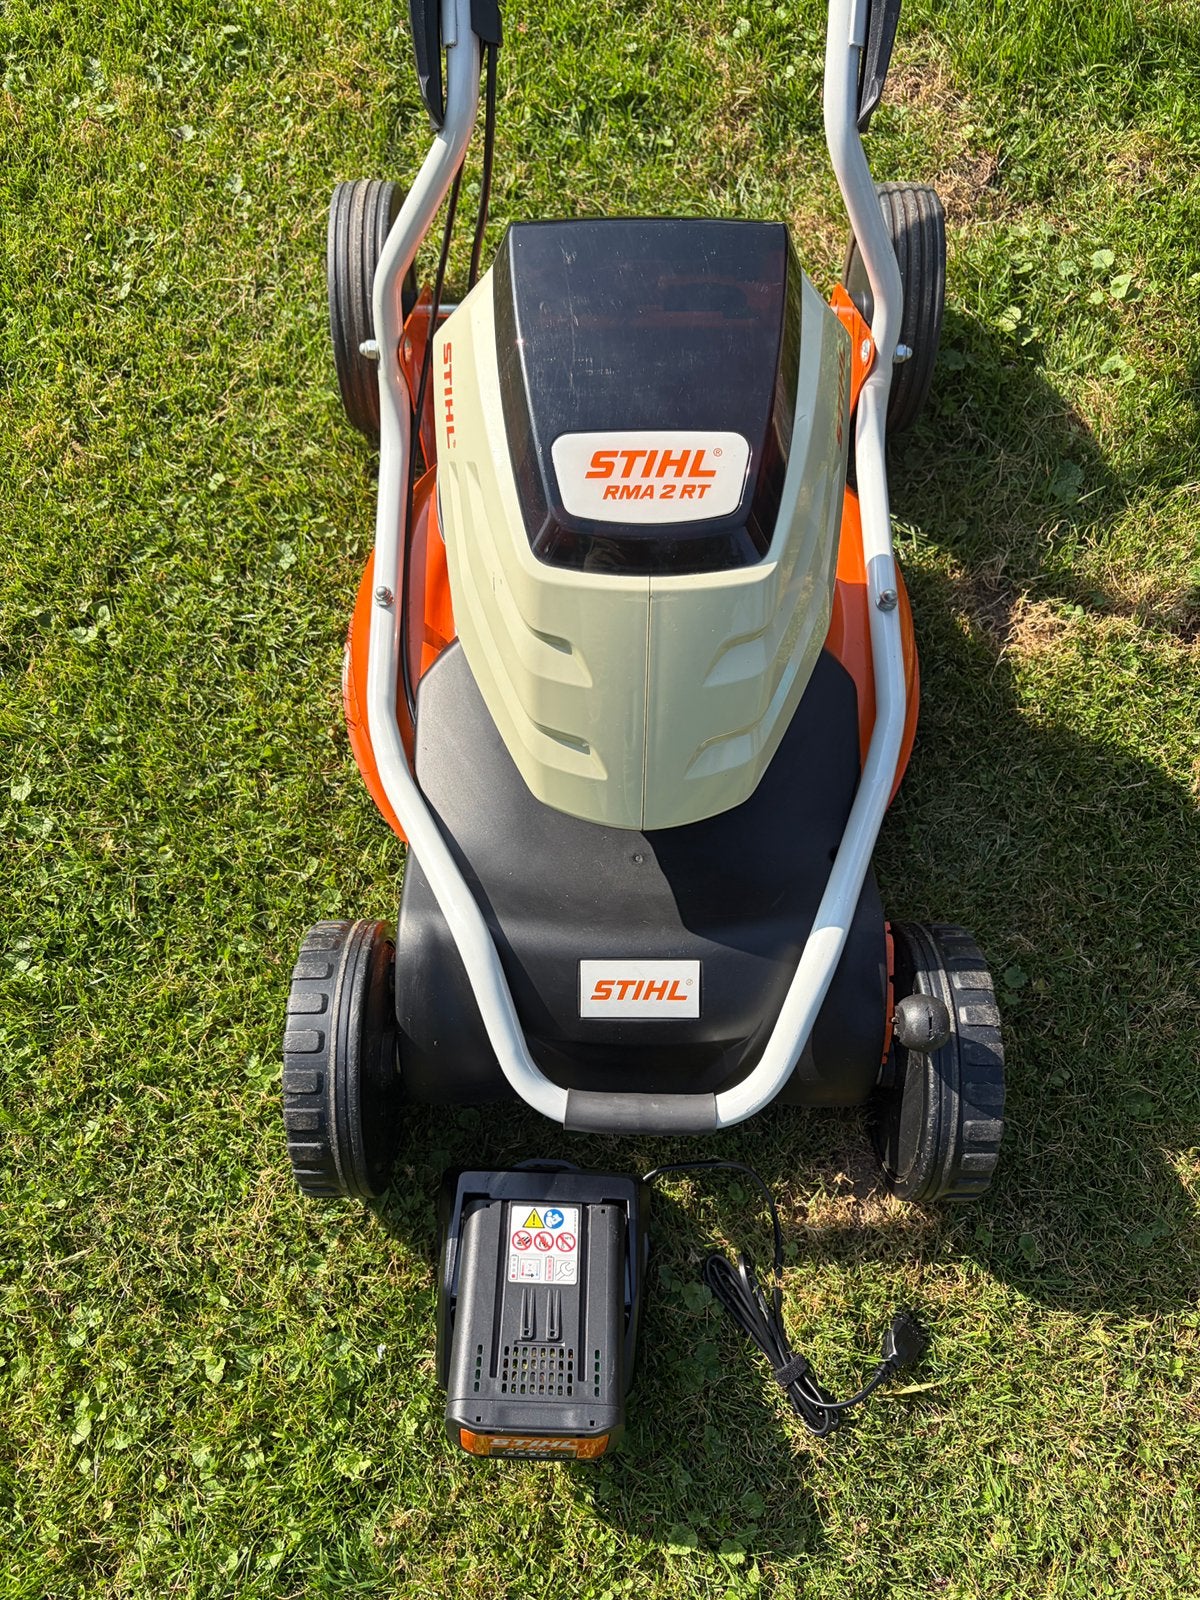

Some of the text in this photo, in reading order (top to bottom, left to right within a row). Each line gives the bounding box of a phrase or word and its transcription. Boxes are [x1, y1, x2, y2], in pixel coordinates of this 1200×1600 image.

[443, 342, 455, 449] STIHL
[585, 449, 717, 479] STIHL
[602, 484, 712, 500] RMA 2 RT
[590, 980, 688, 1001] STIHL
[490, 1438, 578, 1448] STIHL
